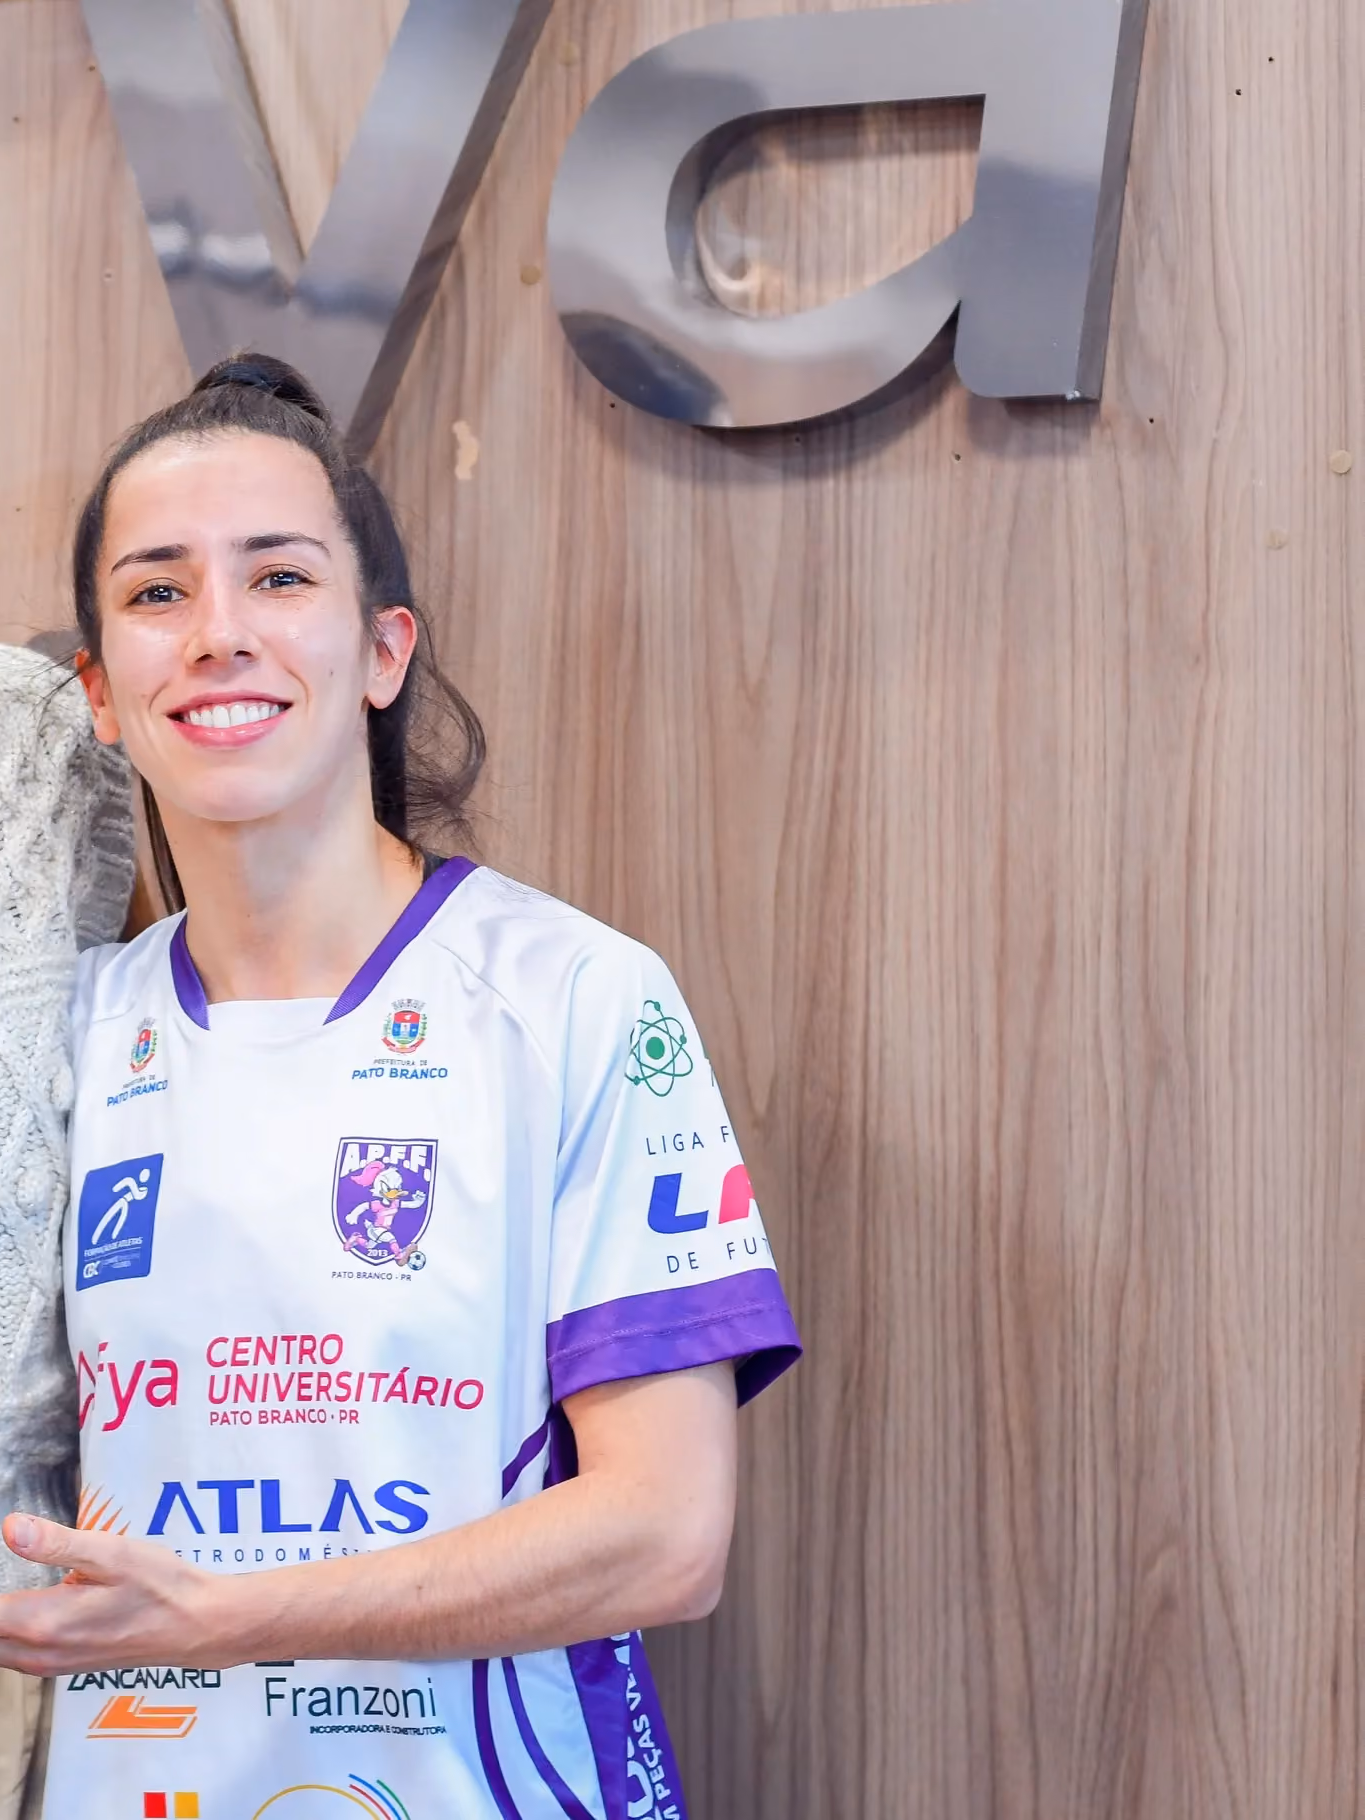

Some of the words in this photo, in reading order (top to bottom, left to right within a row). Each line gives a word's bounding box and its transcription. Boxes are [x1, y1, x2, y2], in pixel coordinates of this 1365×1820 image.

[352, 1067, 384, 1080] PATO
[389, 1067, 448, 1080] BRANCO
[107, 1091, 129, 1107] PATO
[129, 1080, 168, 1098] BRANCO
[645, 1131, 705, 1156] LIGA
[339, 1143, 431, 1182] A.P.F.F.
[367, 1249, 388, 1257] 2013
[666, 1251, 699, 1274] DE
[331, 1271, 354, 1279] PATO
[356, 1272, 393, 1281] BRANCO
[400, 1273, 412, 1281] PR
[206, 1333, 343, 1368] CENTRO
[207, 1367, 484, 1410] UNIVERSITÁRIO
[209, 1409, 253, 1426] PATO
[258, 1408, 327, 1425] BRANCO
[339, 1409, 360, 1425] PR
[146, 1478, 431, 1535] ATLAS
[265, 1676, 436, 1718] Franzoni
[310, 1724, 384, 1734] INCORPORADORA
[391, 1726, 447, 1736] CONSTRUTORA
[633, 1713, 671, 1801] PEÇAS
